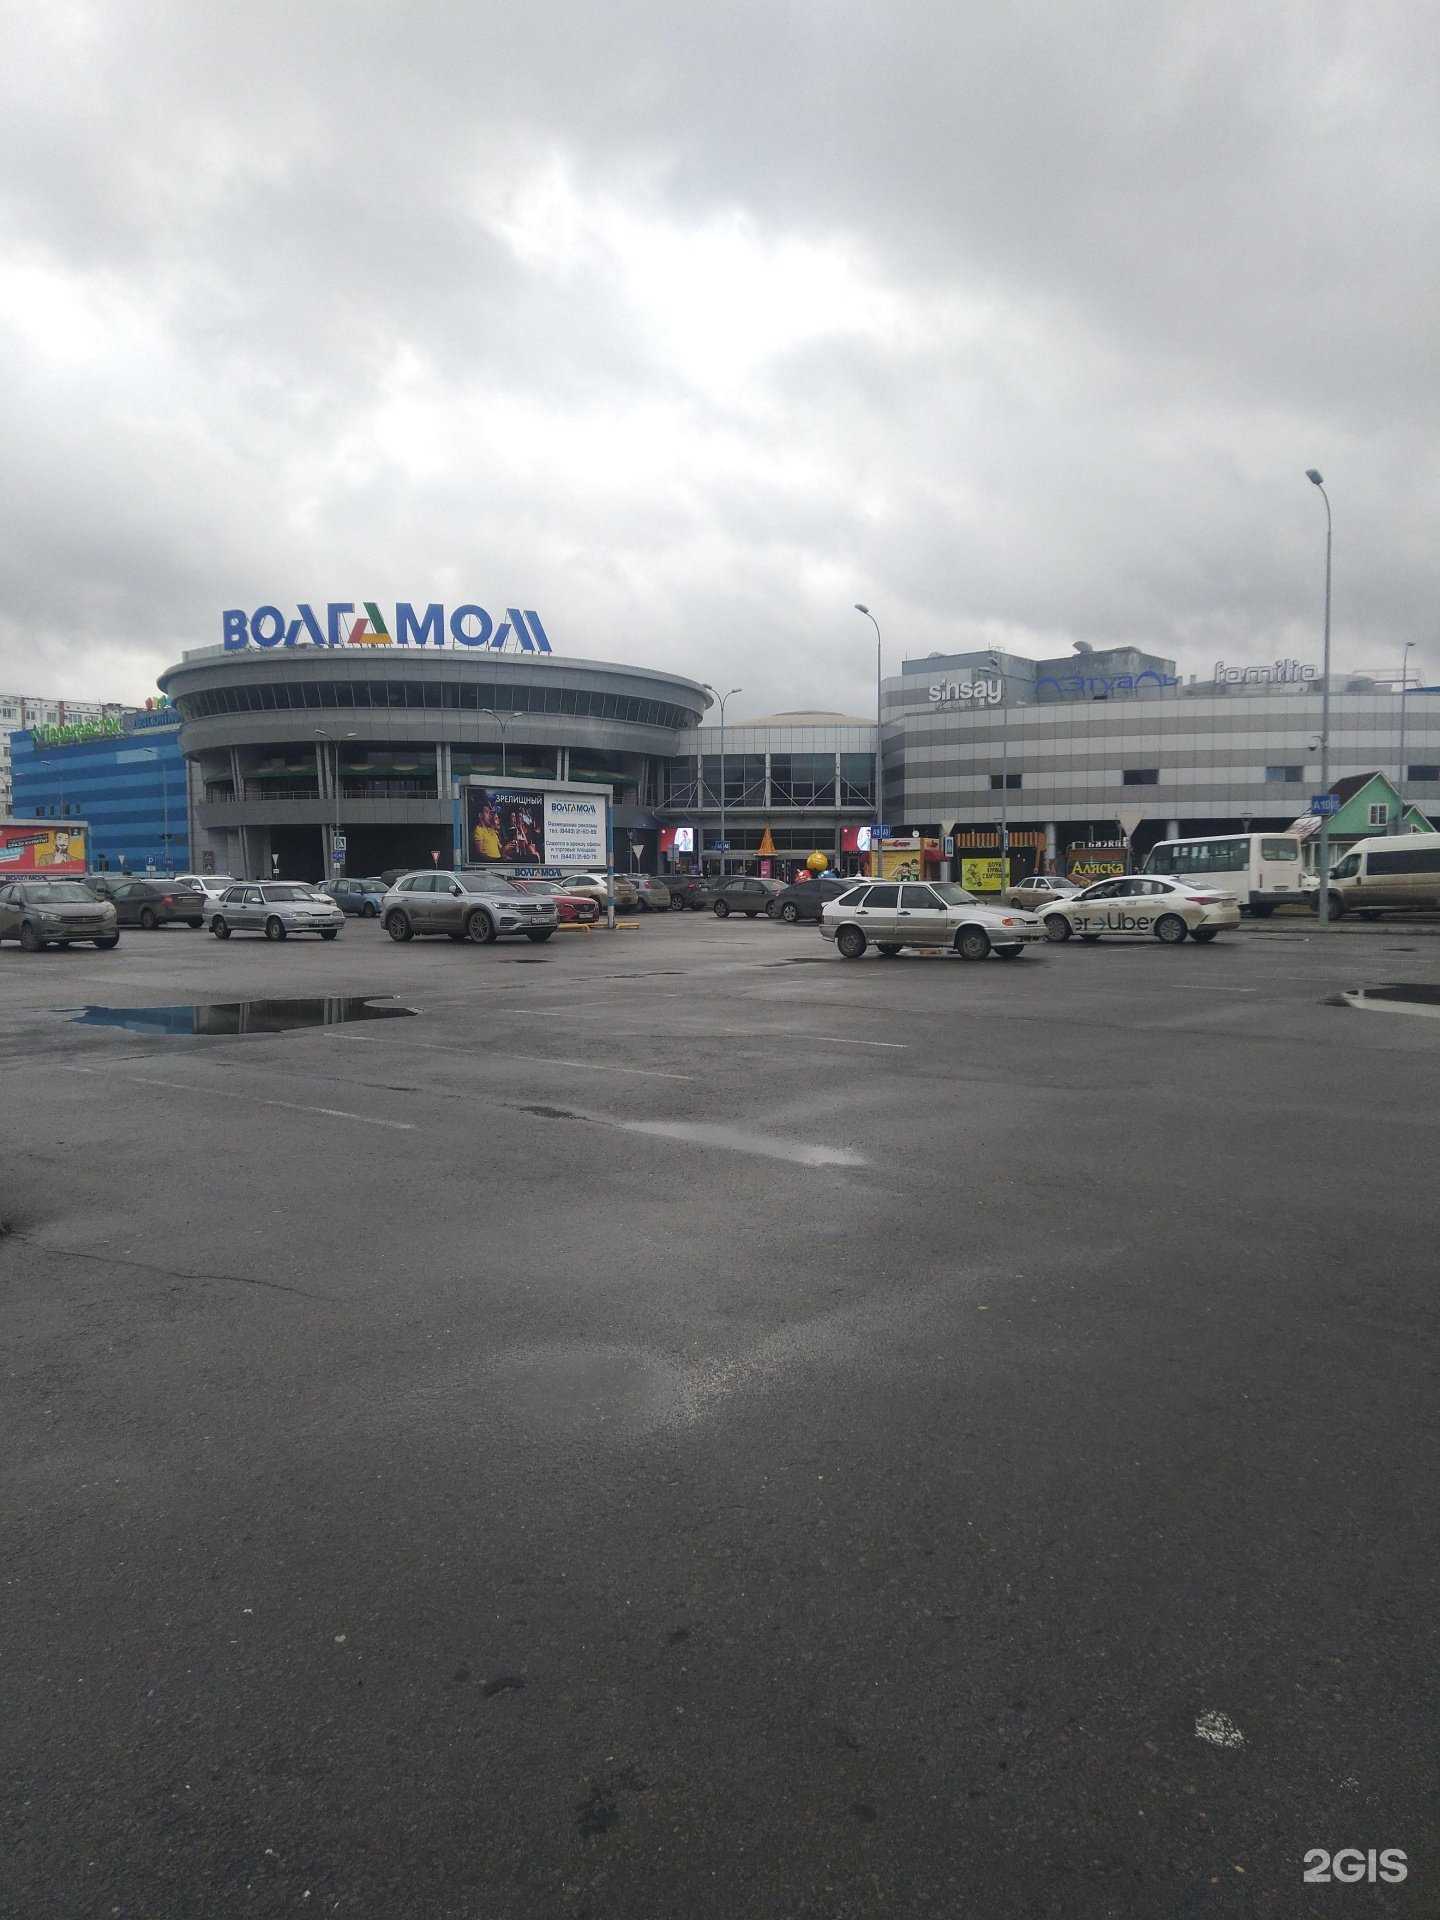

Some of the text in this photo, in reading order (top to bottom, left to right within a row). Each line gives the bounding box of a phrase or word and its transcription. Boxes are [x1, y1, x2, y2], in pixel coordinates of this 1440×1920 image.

[928, 678, 1002, 704] sinsay
[495, 794, 542, 805] ЗРЕЛИЩНЫЙ
[1072, 861, 1124, 874] Аляска
